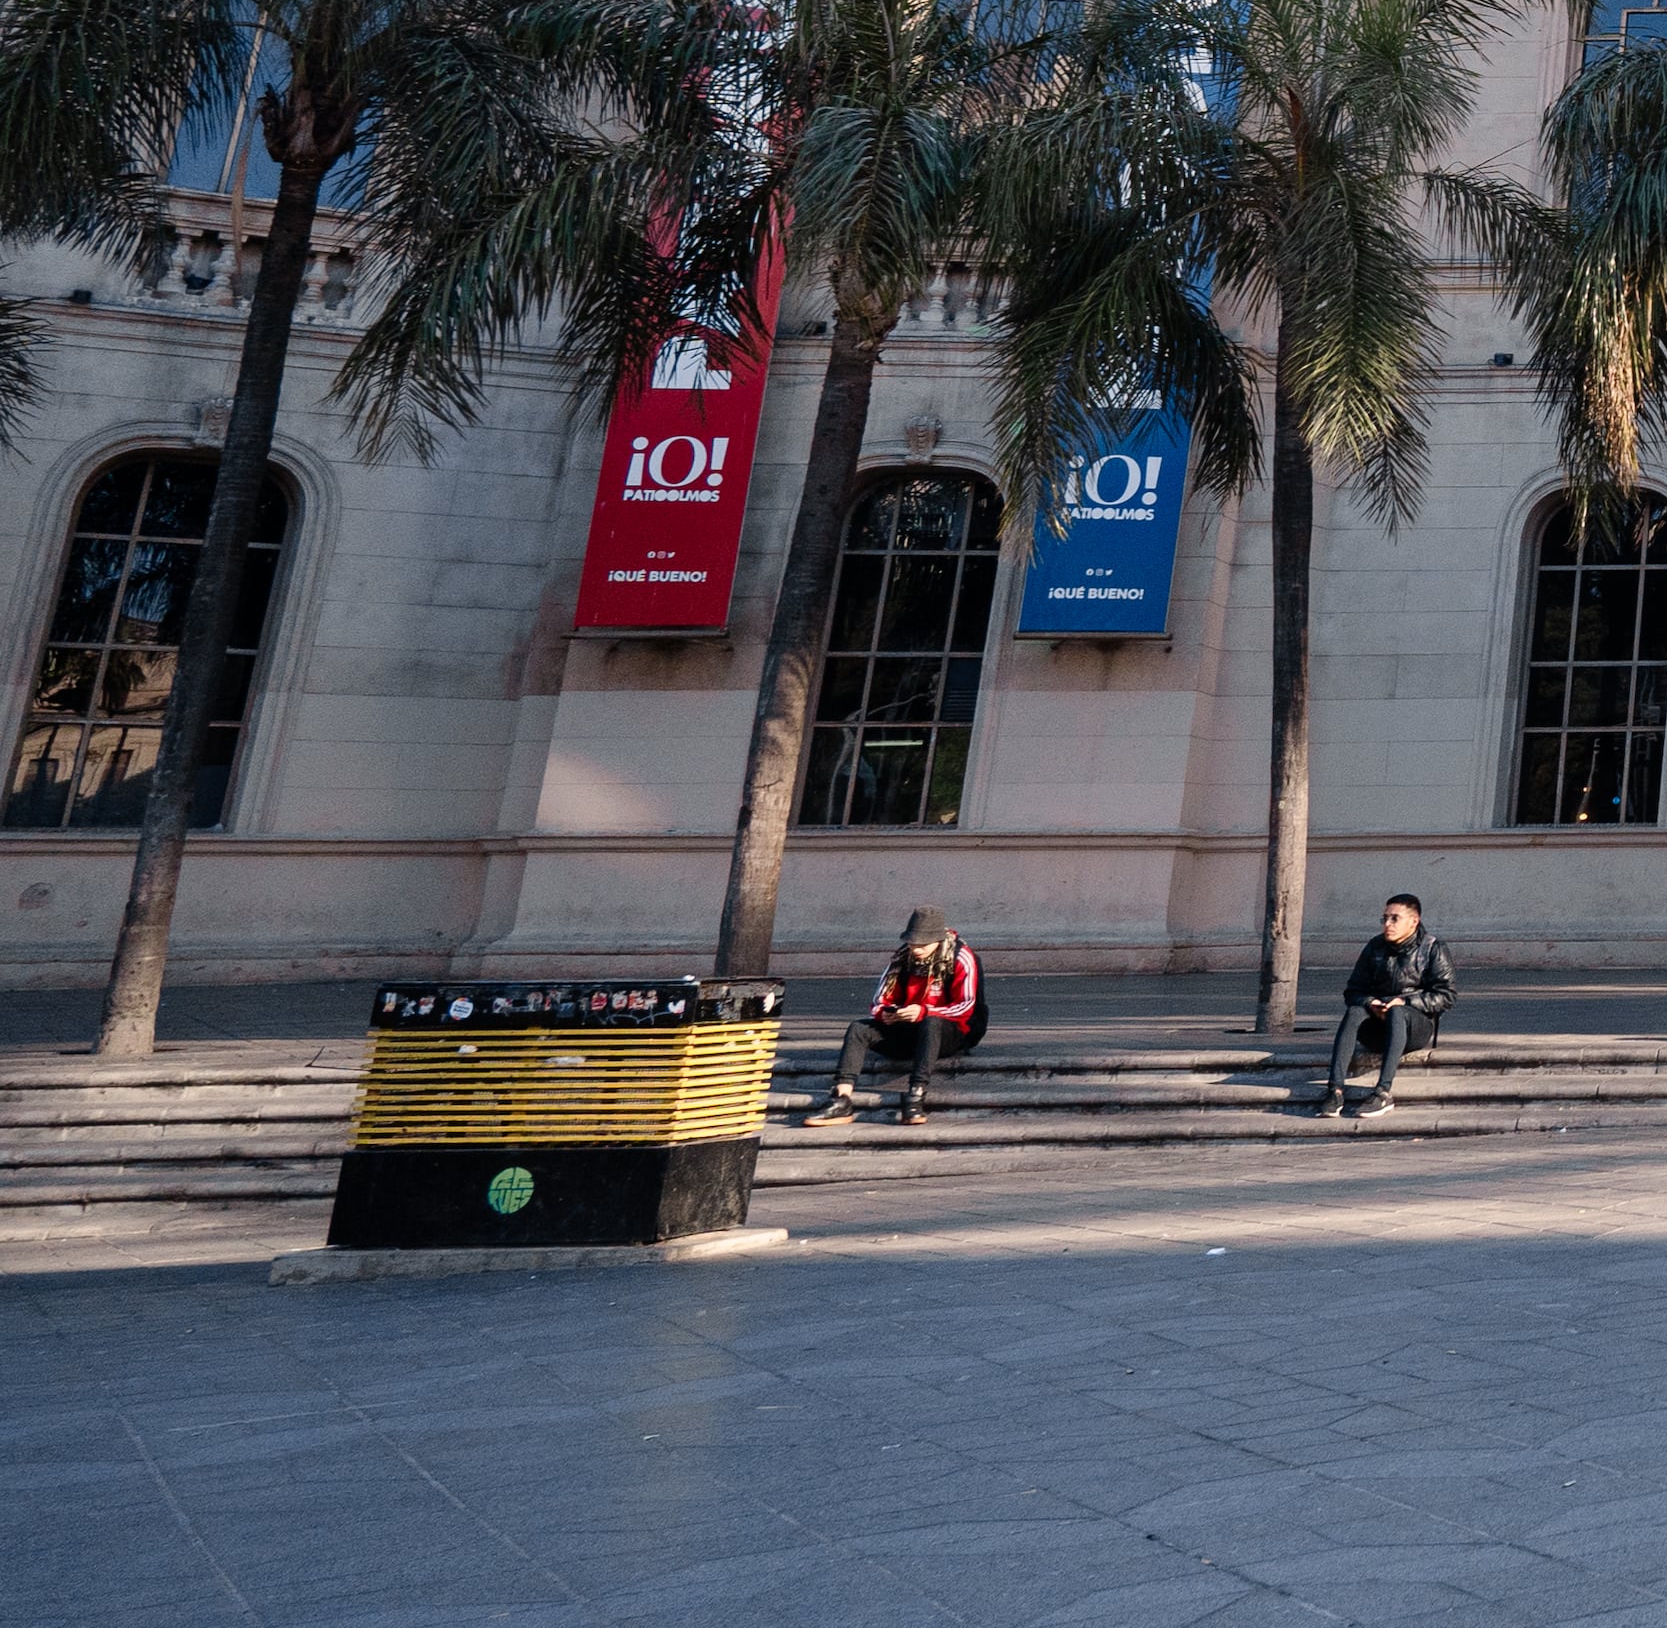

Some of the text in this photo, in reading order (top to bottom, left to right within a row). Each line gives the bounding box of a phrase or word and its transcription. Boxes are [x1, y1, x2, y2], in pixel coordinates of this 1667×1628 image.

[608, 569, 707, 582] ¡QUÉ BUENO!
[1048, 586, 1144, 600] ¡QUÉ BUENO!
